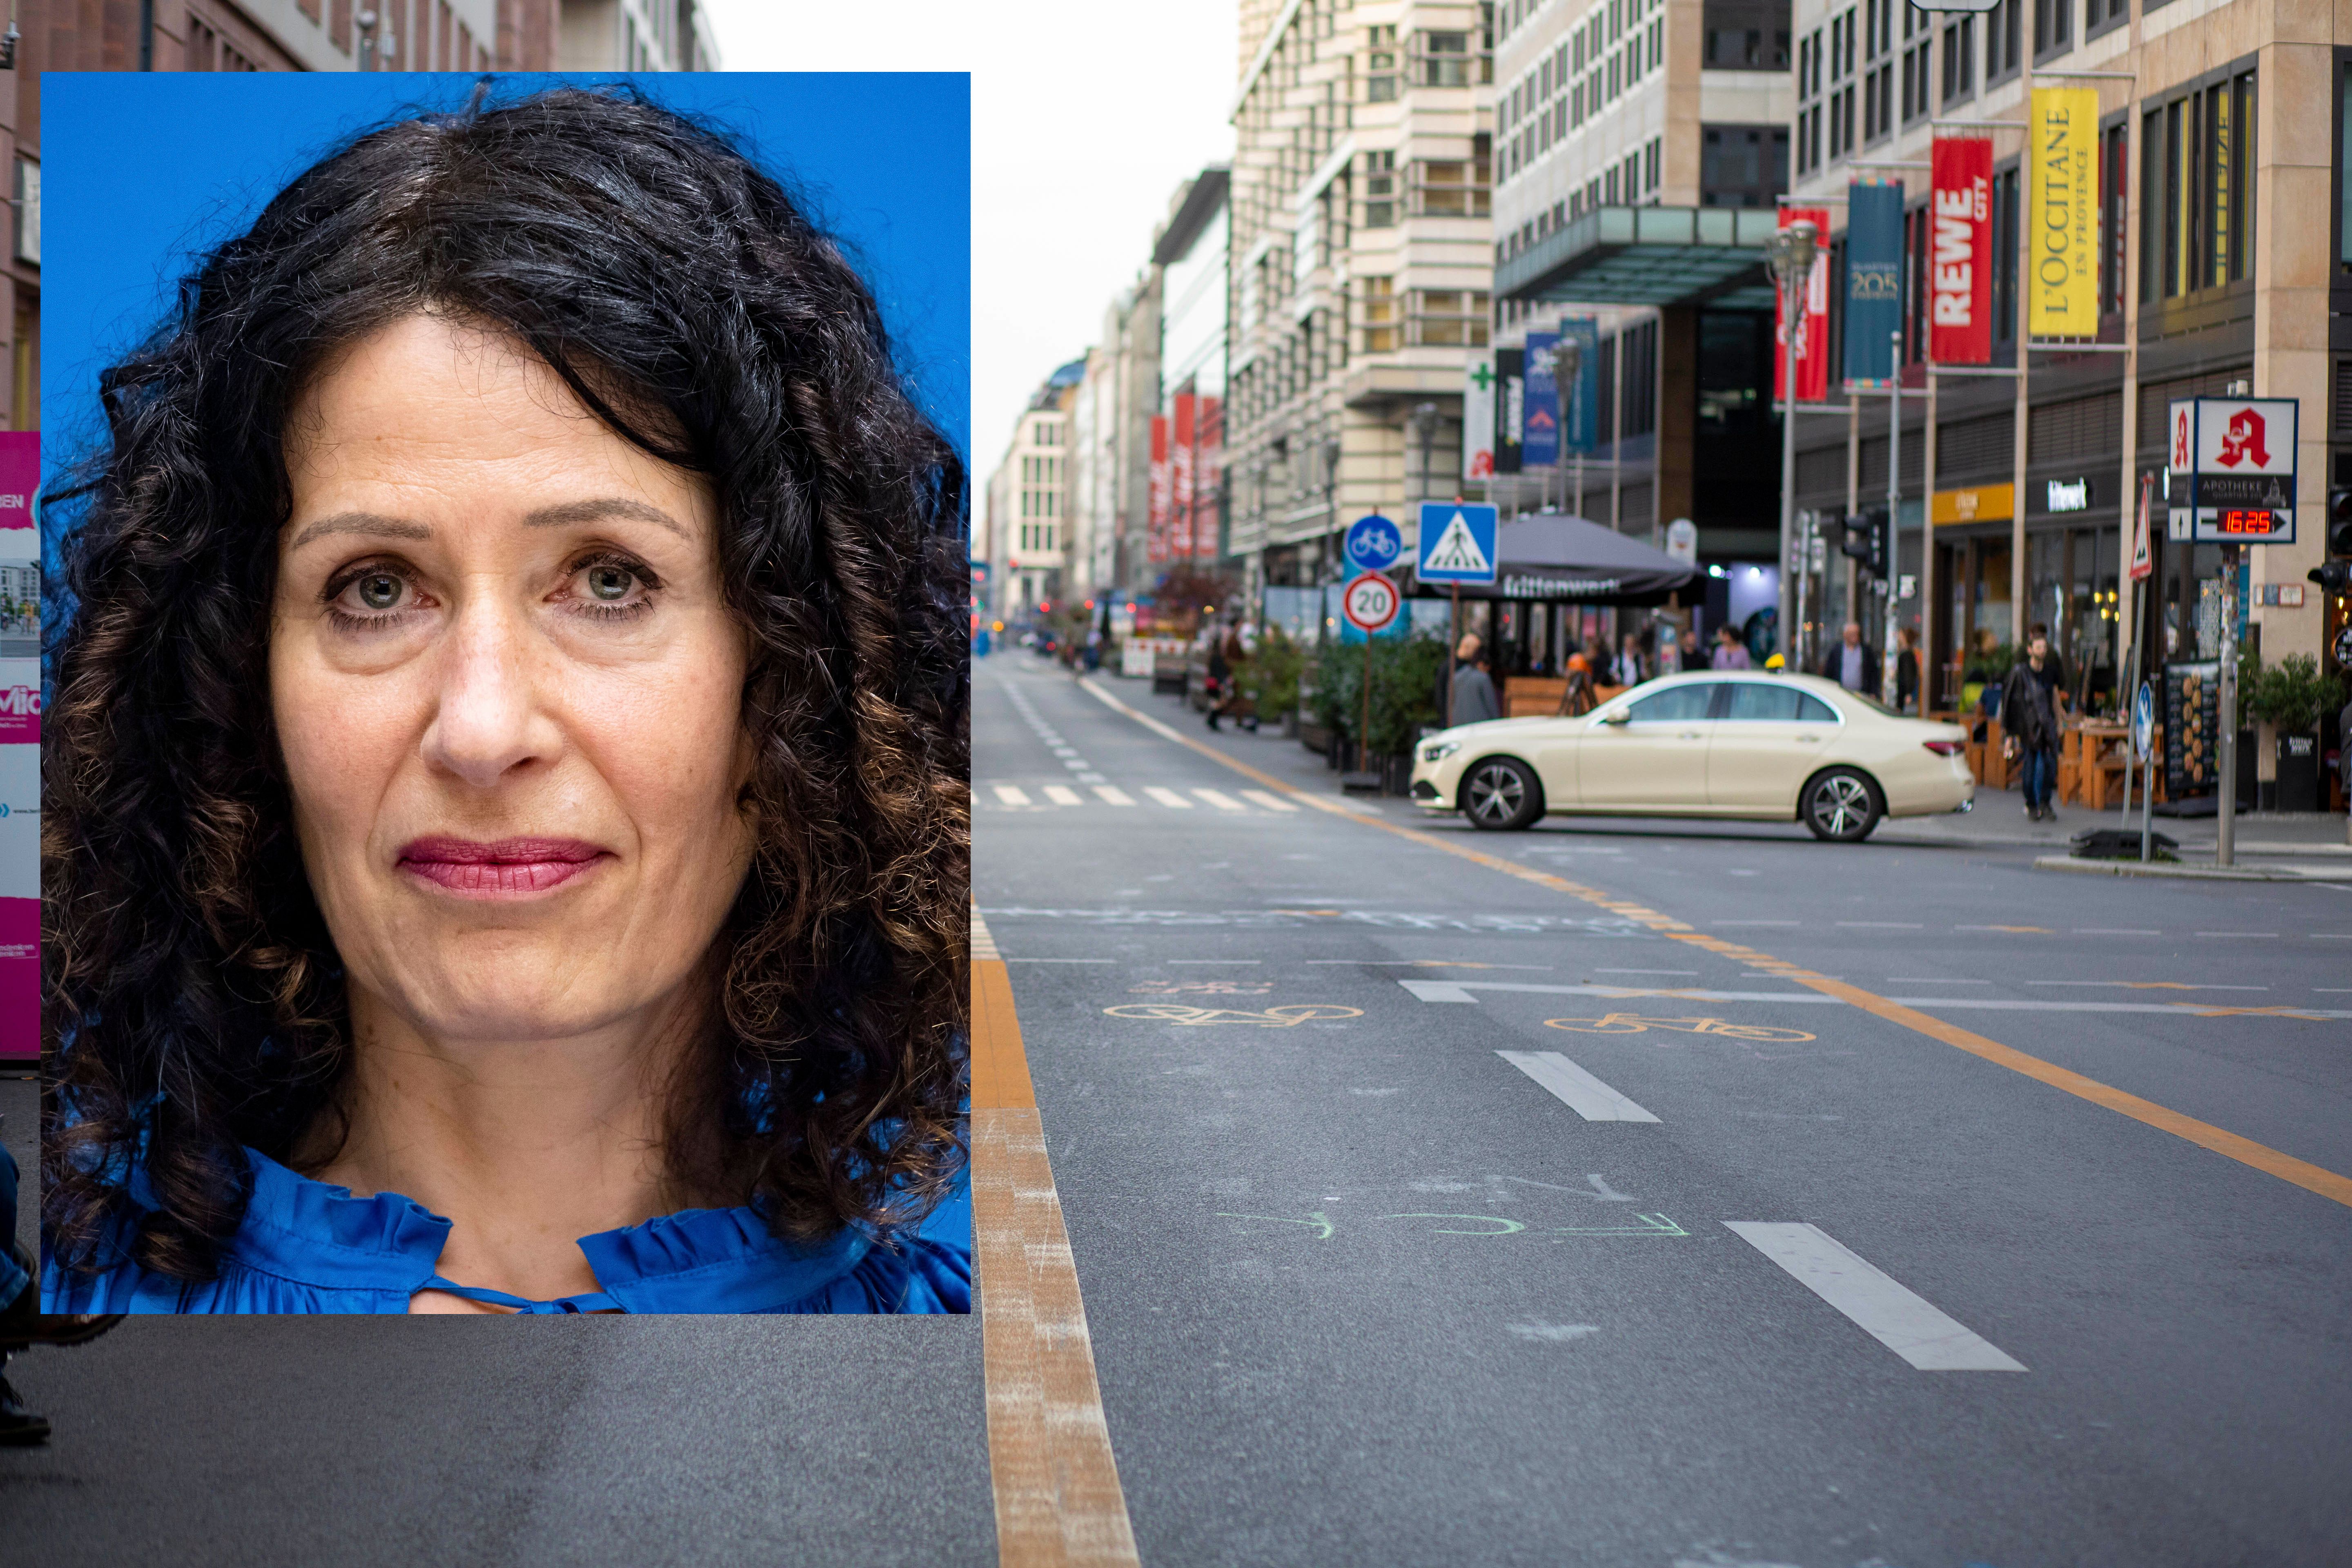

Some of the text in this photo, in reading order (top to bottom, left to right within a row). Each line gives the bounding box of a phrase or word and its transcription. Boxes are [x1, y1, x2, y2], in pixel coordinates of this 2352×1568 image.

[1973, 176, 1988, 223] CITY
[2041, 106, 2070, 315] L'OCCITANE
[2076, 147, 2089, 276] EN PROVENCE
[1934, 188, 1973, 327] REWE
[1851, 273, 1898, 299] 205
[2203, 479, 2262, 491] APOTHEKE
[1358, 590, 1386, 615] 20
